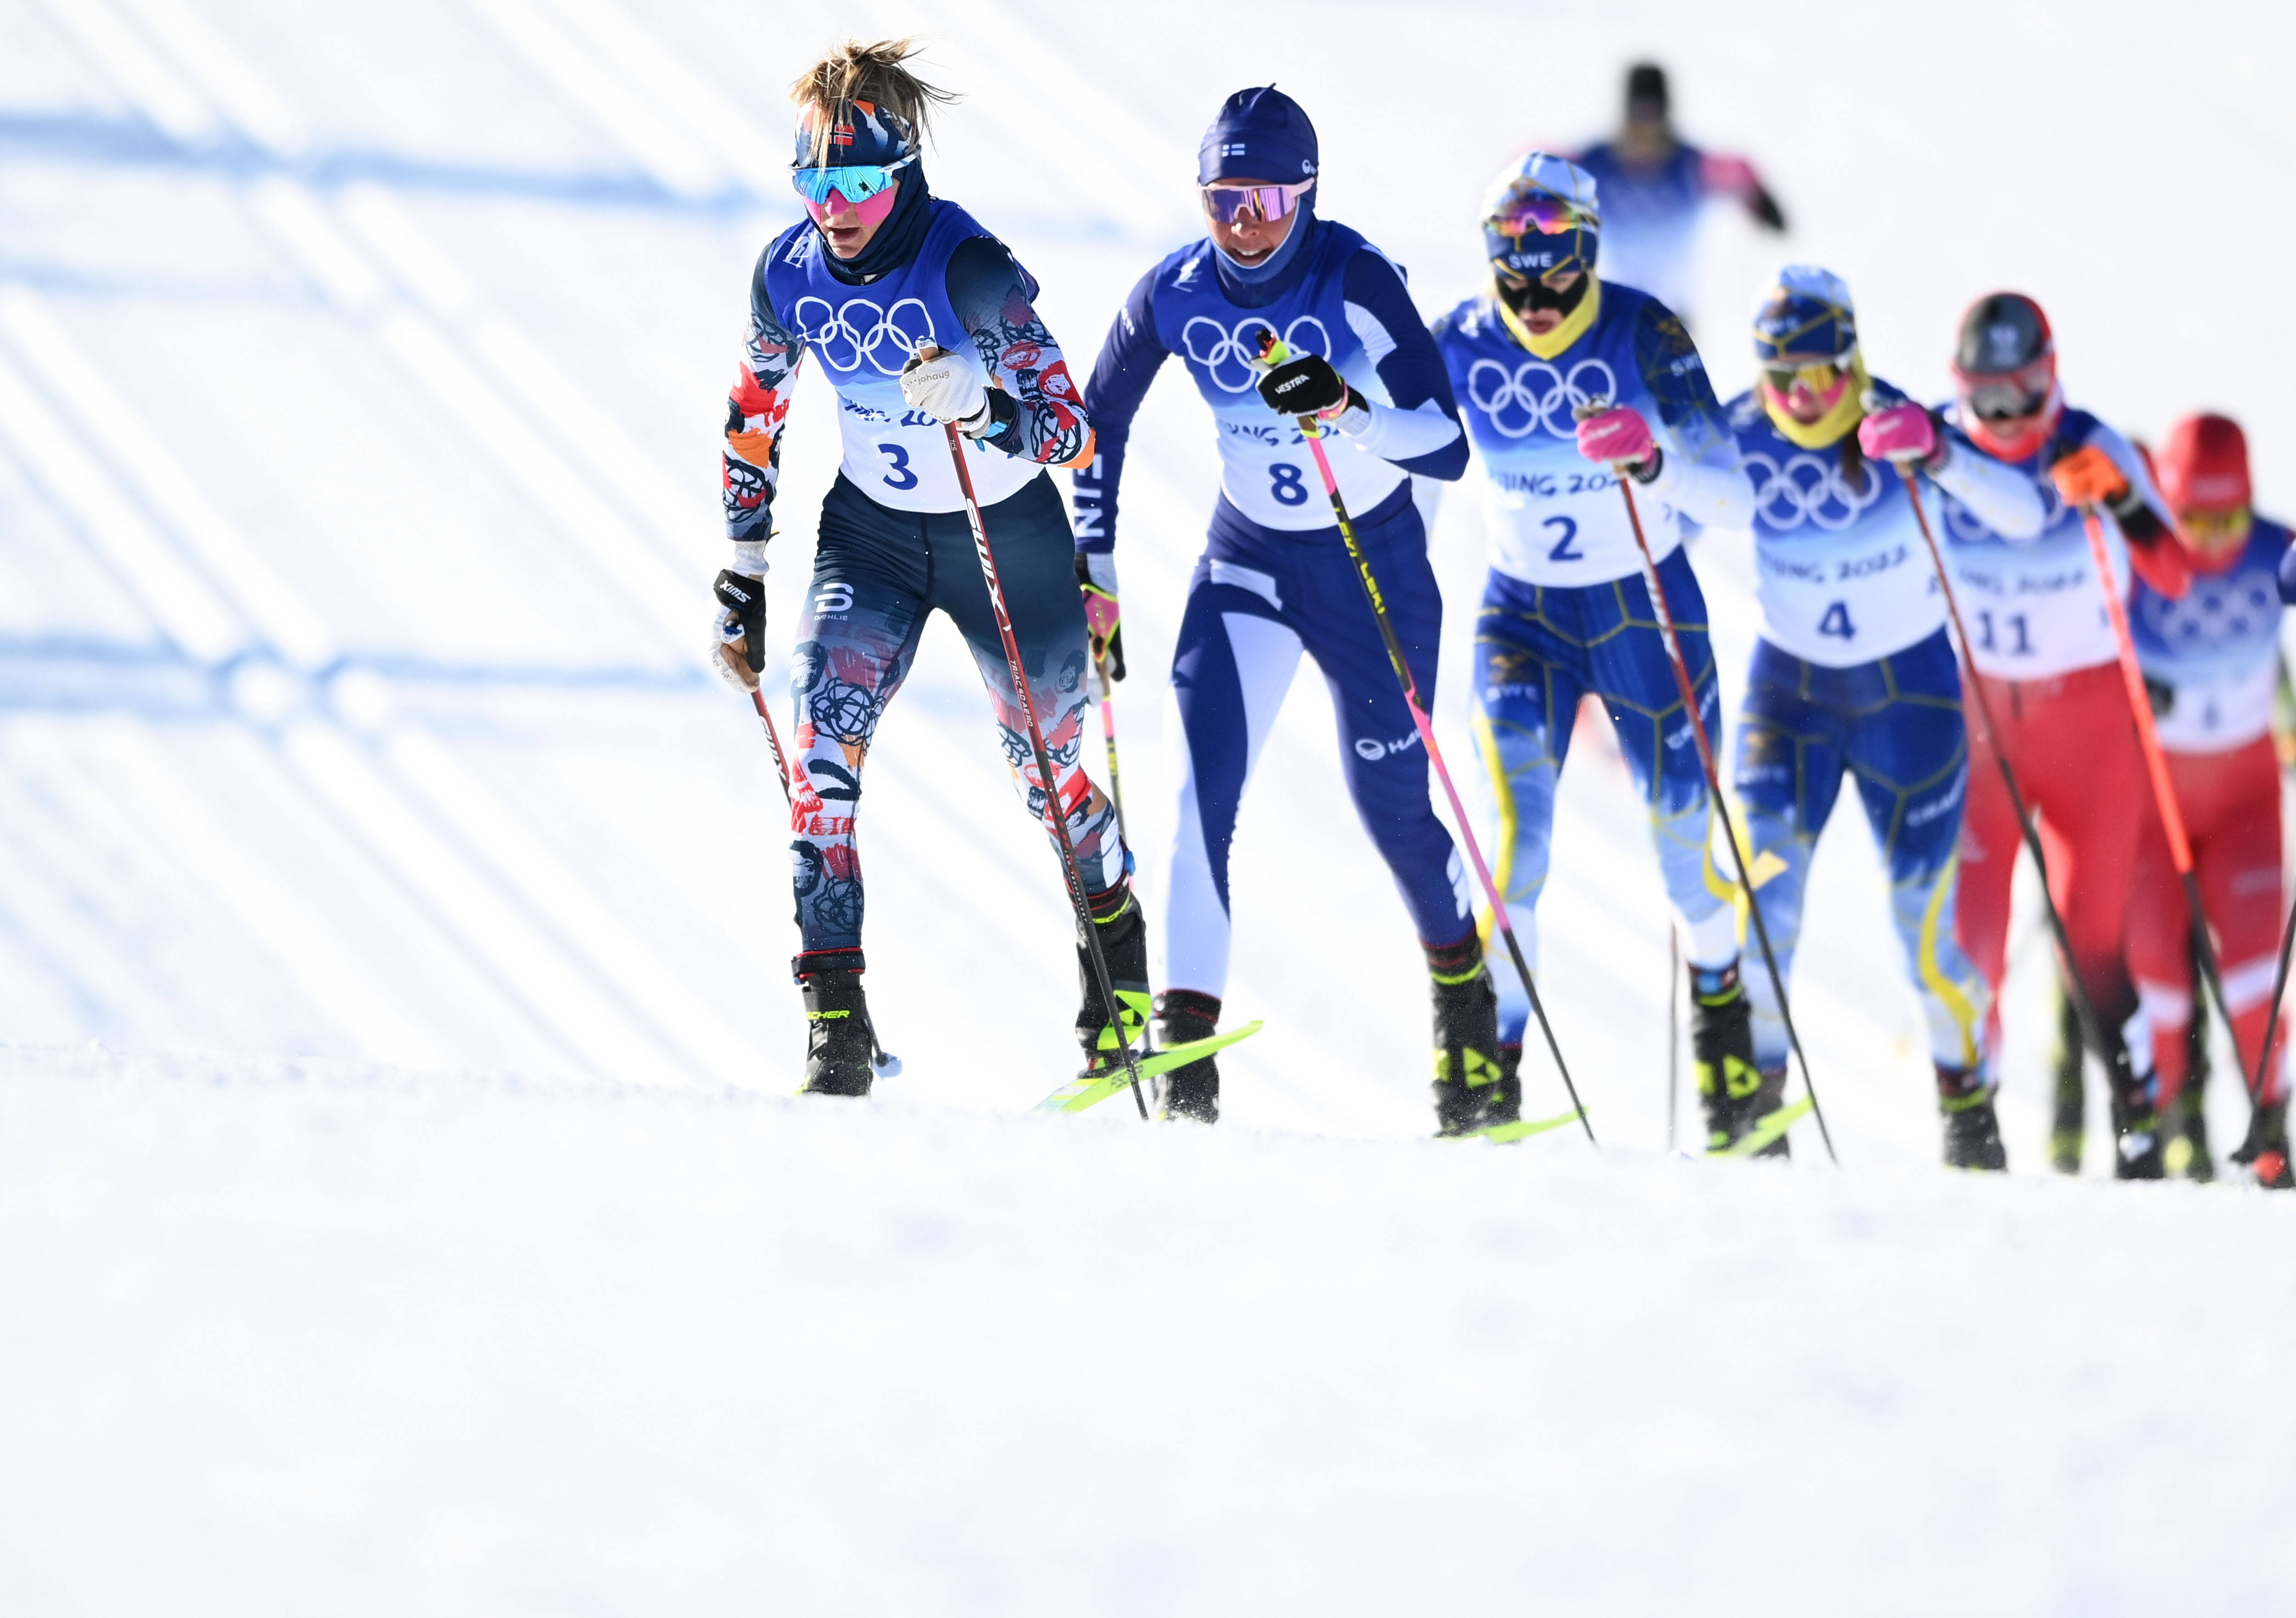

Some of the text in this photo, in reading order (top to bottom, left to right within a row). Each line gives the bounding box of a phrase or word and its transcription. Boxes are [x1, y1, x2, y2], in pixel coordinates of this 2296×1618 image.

[1508, 252, 1553, 270] SWE
[917, 371, 950, 385] johaug
[878, 444, 918, 490] 3
[949, 438, 958, 452] TCS
[1268, 463, 1308, 506] 8
[964, 497, 1006, 618] SWIX
[1542, 516, 1583, 562] 2
[719, 579, 751, 603] SWIX
[1361, 562, 1386, 615] LEKI
[1817, 600, 1856, 640] 4
[1975, 609, 2036, 657] 11
[1010, 660, 1022, 687] TRIAC
[1021, 701, 1033, 727] AERO
[1070, 871, 1087, 922] TECHNOLOGY
[806, 1011, 850, 1020] SCHER
